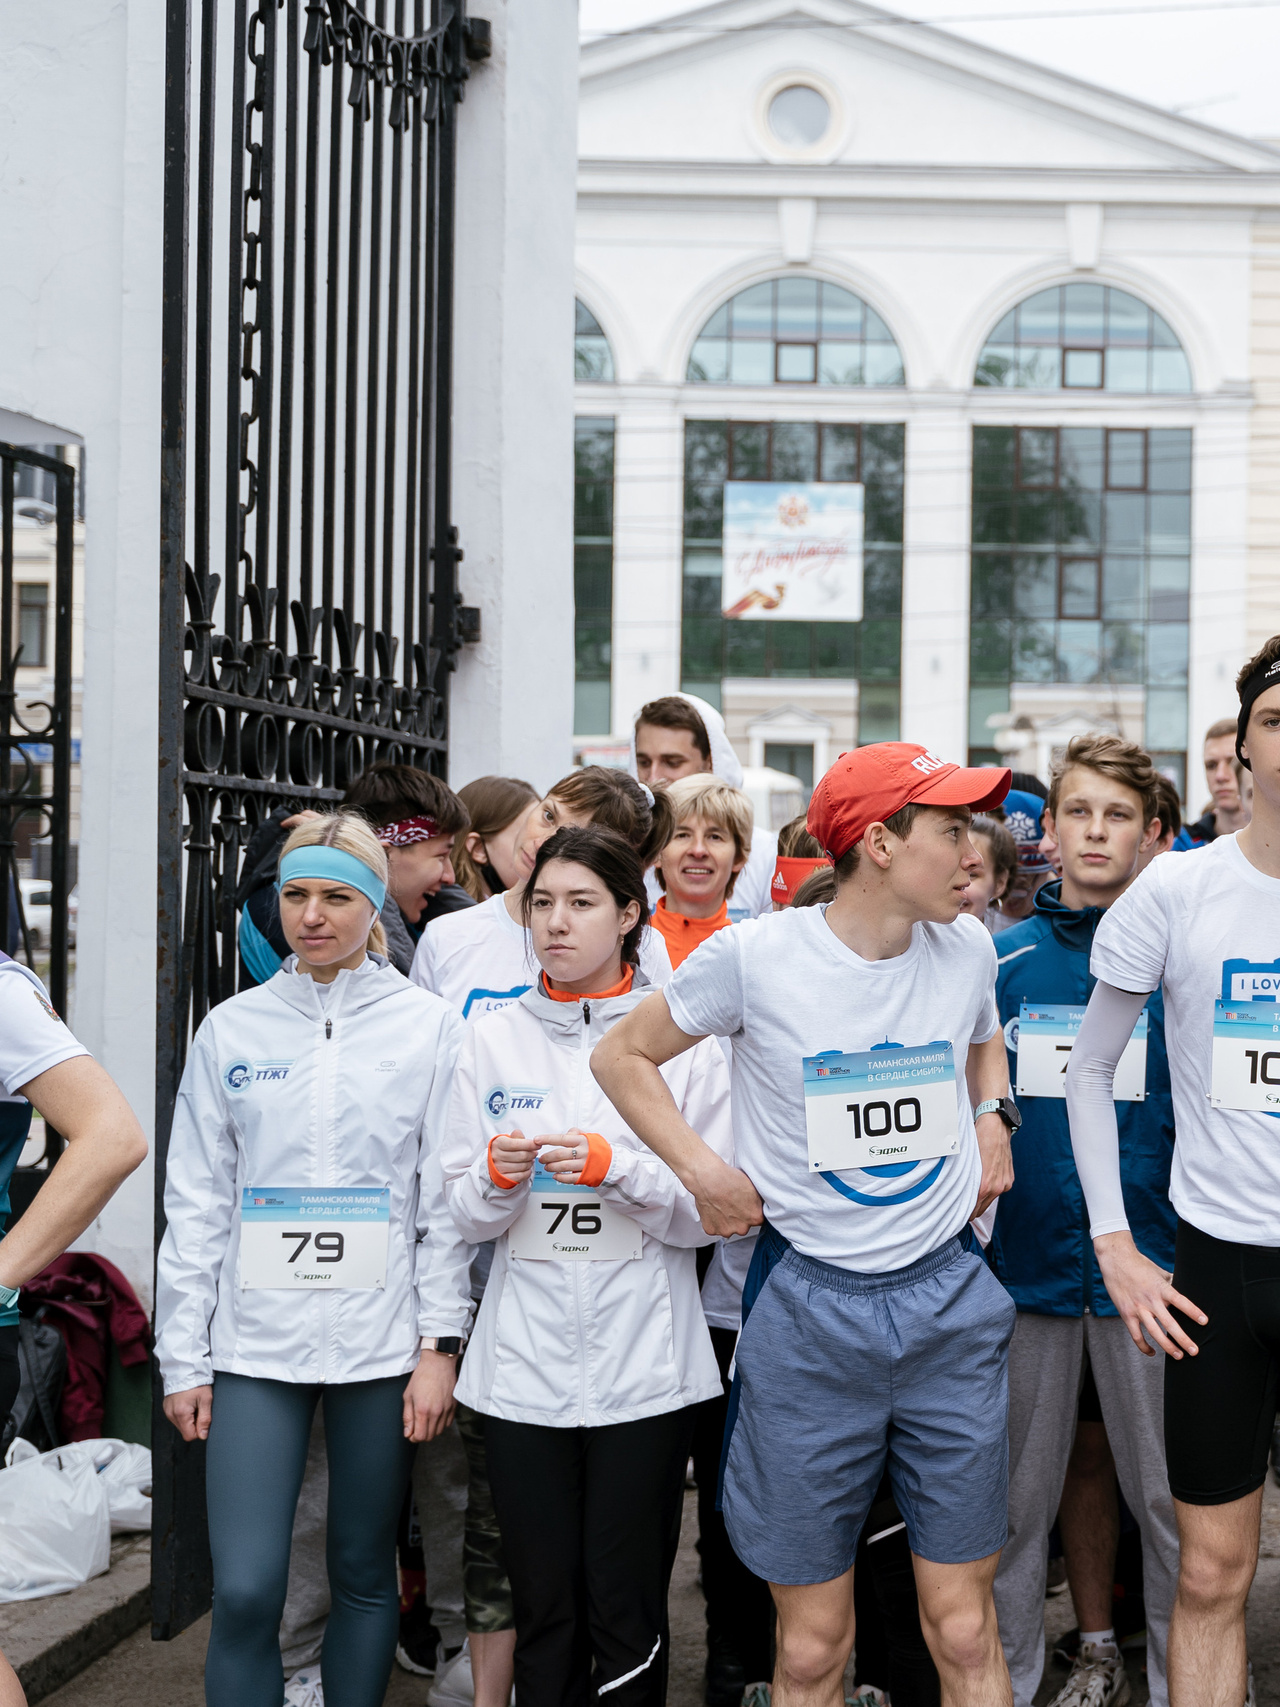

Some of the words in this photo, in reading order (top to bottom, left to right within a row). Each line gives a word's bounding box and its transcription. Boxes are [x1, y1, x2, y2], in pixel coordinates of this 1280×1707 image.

[1241, 979, 1245, 990] I
[1272, 1025, 1279, 1033] В
[867, 1057, 920, 1070] ТАМАНСКАЯ
[921, 1053, 946, 1063] МИЛЯ
[868, 1074, 874, 1082] В
[875, 1070, 910, 1082] СЕРДЦЕ
[911, 1066, 945, 1077] СИБИРИ
[846, 1097, 922, 1139] 100
[301, 1196, 353, 1205] ТАМАНСКАЯ
[354, 1196, 380, 1205] МИЛЯ
[300, 1207, 305, 1215] В
[306, 1207, 341, 1217] СЕРДЦЕ
[343, 1207, 378, 1215] СИБИРИ
[541, 1203, 603, 1235] 76
[282, 1231, 345, 1264] 79
